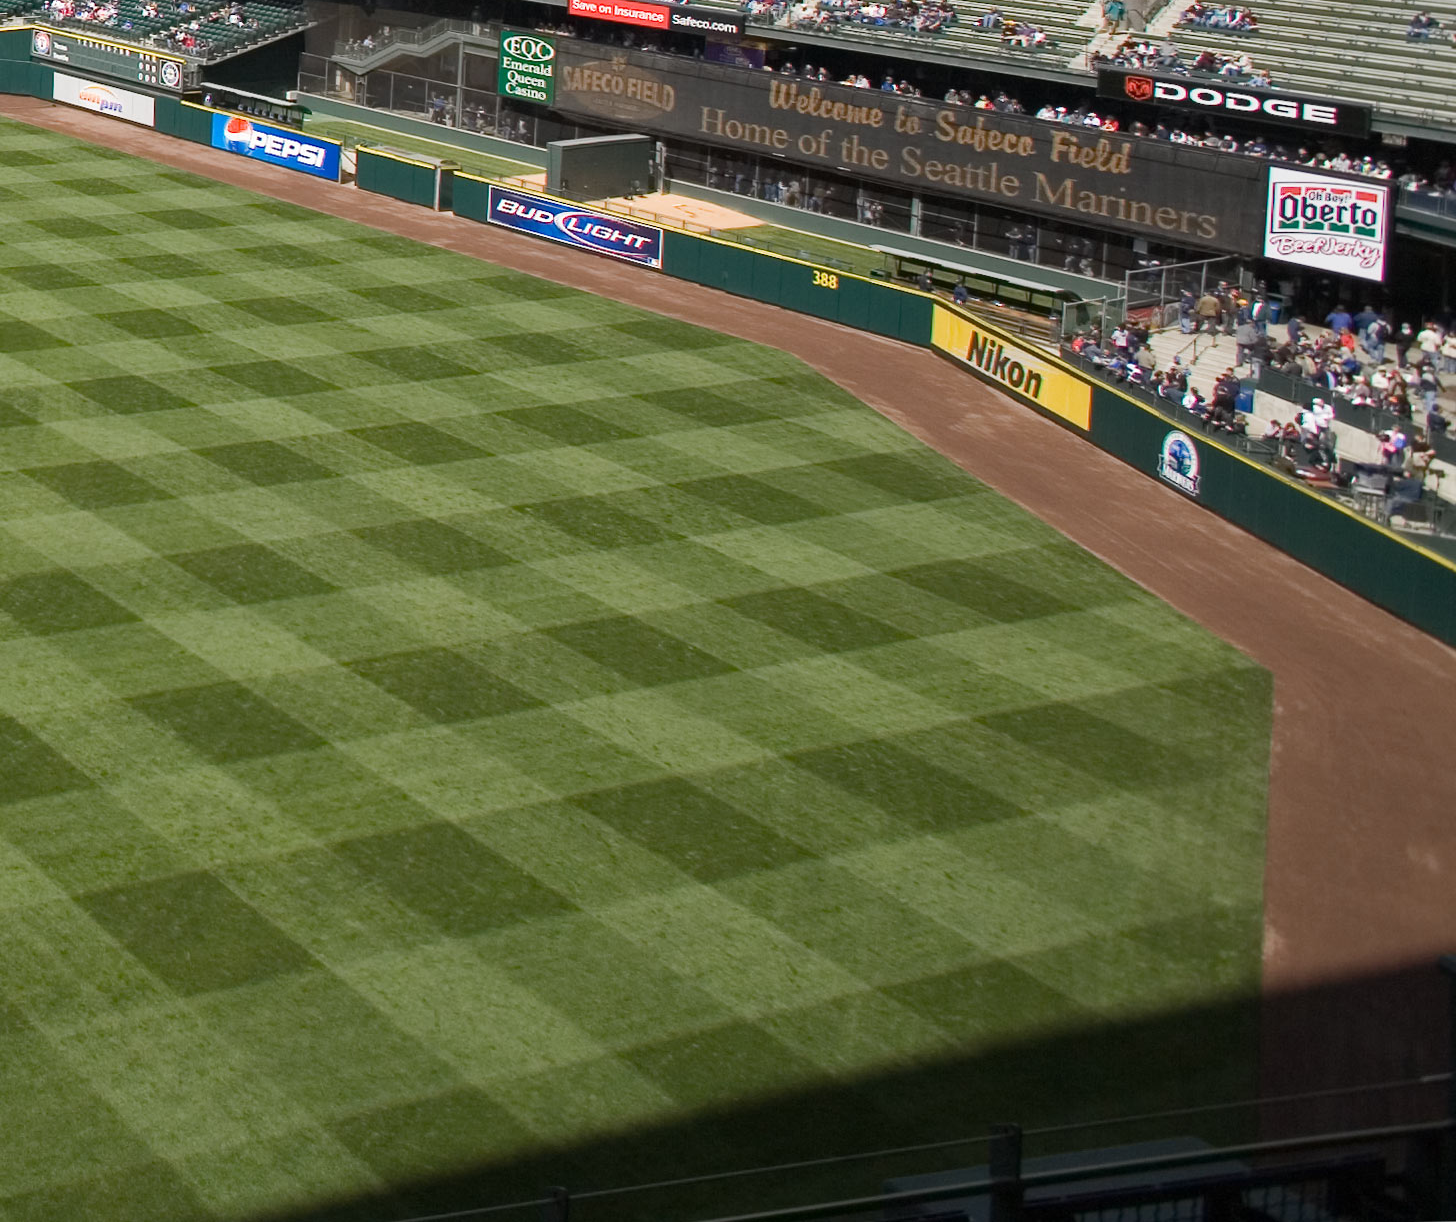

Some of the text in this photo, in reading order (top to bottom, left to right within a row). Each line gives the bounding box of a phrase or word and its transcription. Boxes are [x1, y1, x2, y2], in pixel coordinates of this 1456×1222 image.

[572, 0, 665, 23] Save on Insurance
[672, 14, 739, 34] Safeco.com
[510, 38, 550, 59] EQC
[503, 56, 553, 77] Emerald
[507, 70, 547, 89] Queen
[505, 82, 547, 101] Casino
[563, 66, 624, 95] SAFECO
[626, 78, 676, 112] FIELD
[1153, 81, 1337, 125] DODGE
[769, 79, 1132, 174] Welcome to Safeco Field
[248, 129, 326, 167] PEPSI
[699, 106, 1217, 240] Home of the Seattle Mariners
[1279, 194, 1377, 227] Oberto
[1308, 191, 1350, 204] Oh Boy!
[496, 198, 653, 250] BUD LIGHT
[812, 270, 839, 290] 388
[965, 329, 1043, 398] Nikon
